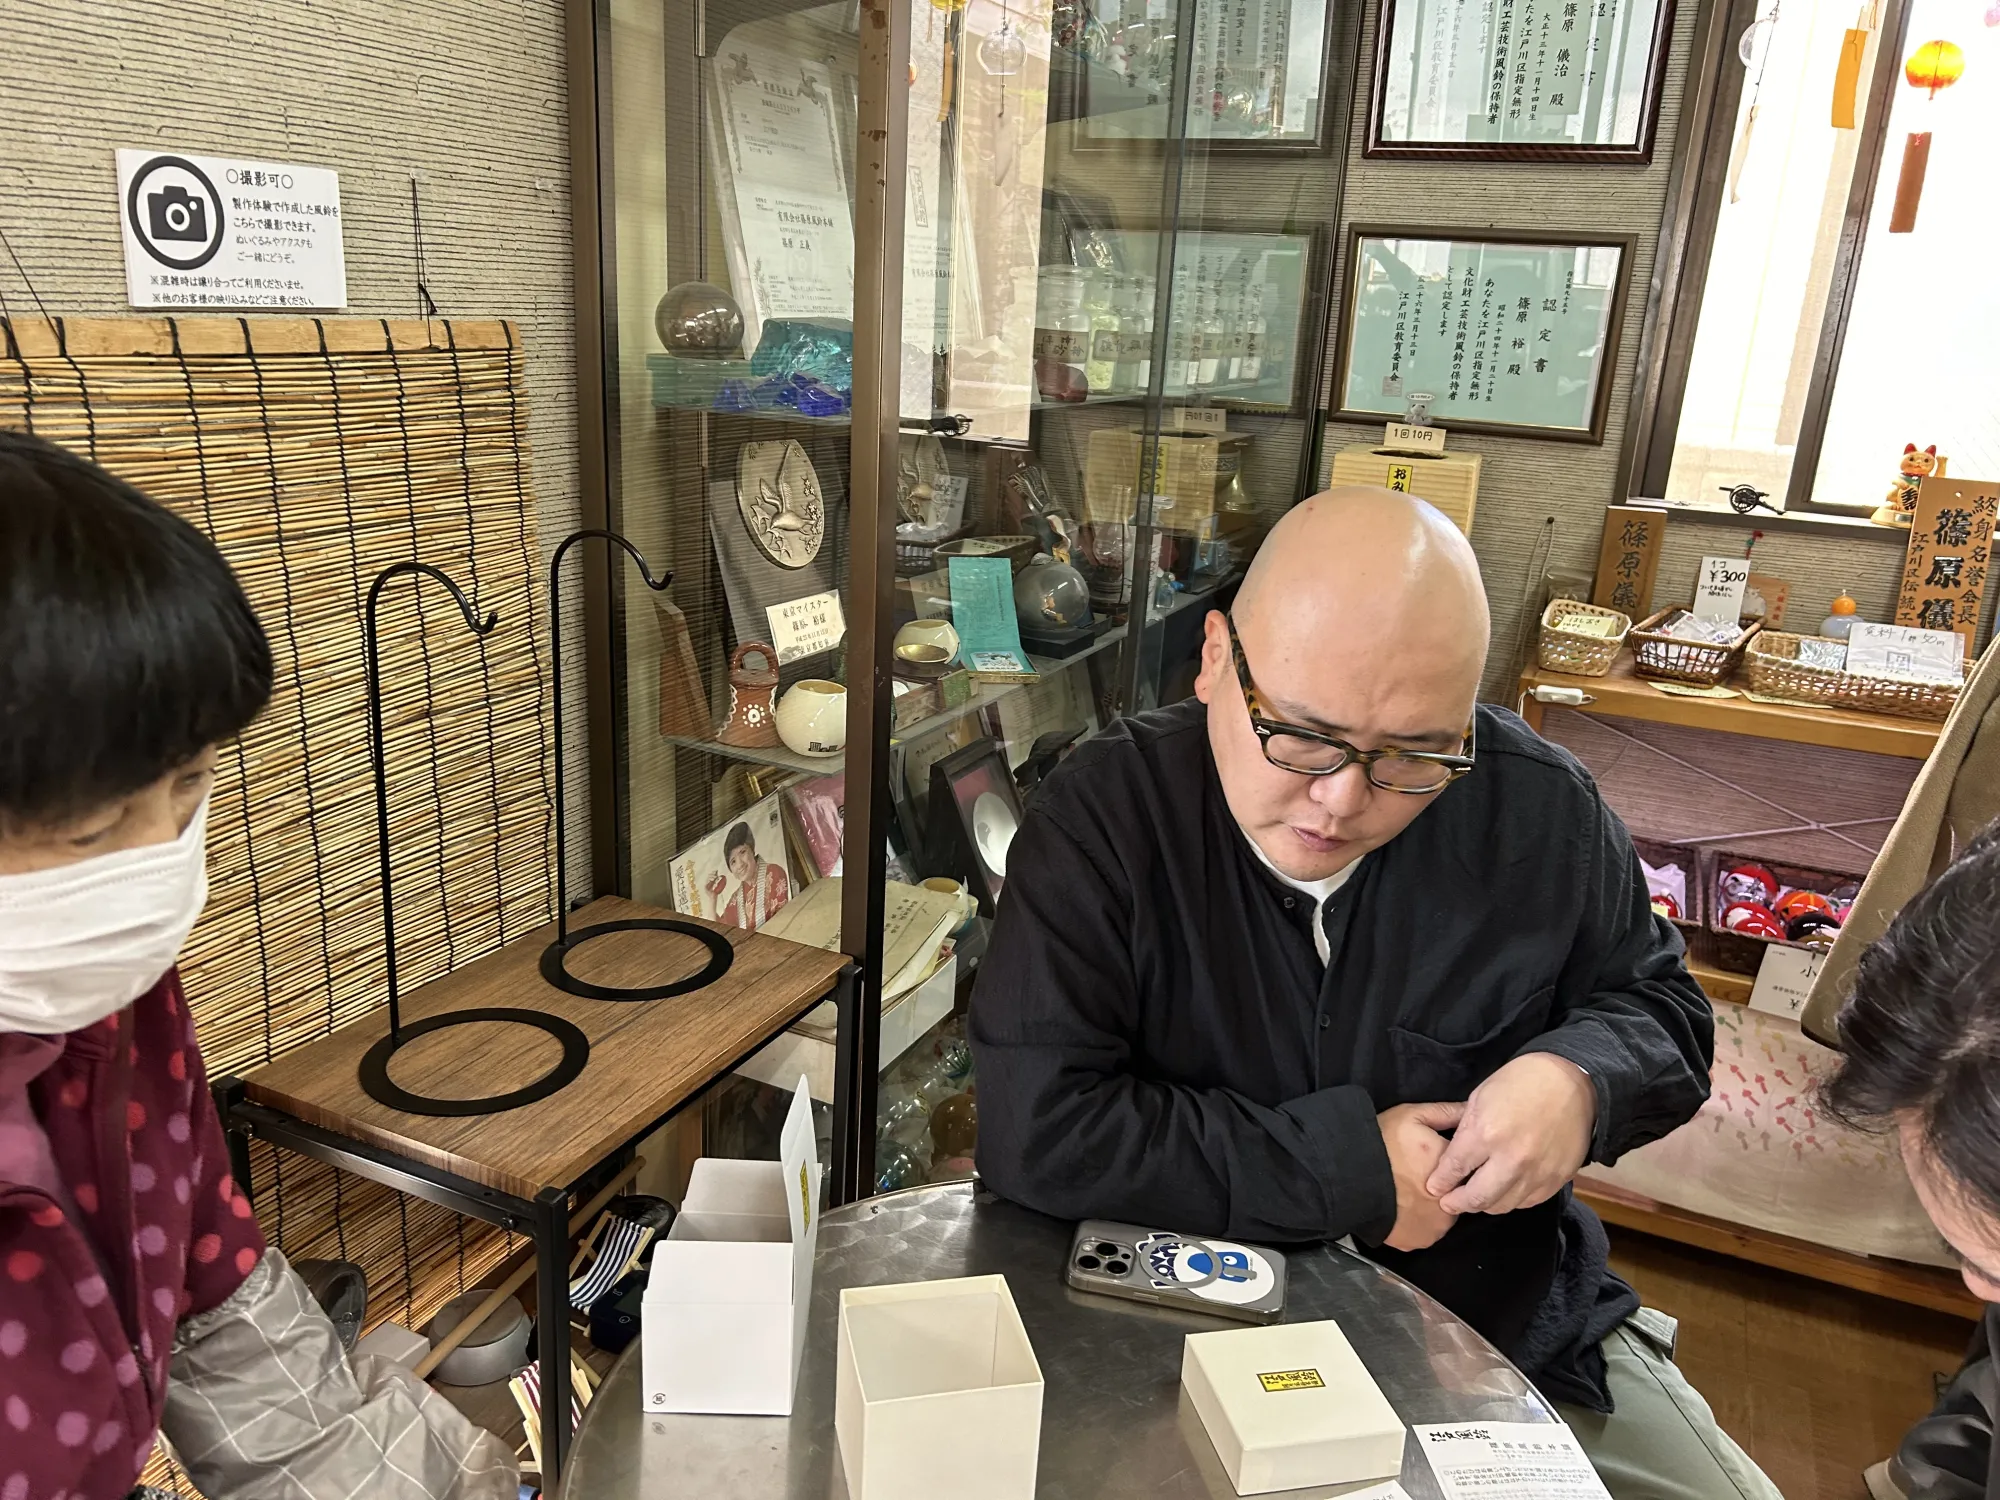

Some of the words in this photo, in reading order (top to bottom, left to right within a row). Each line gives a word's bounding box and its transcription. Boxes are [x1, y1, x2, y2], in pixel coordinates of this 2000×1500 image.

[1561, 2, 1578, 32] 篠原
[1509, 0, 1535, 119] たを江戸川区指定無形
[1528, 12, 1551, 121] 大正十三年十一月十四日生
[1554, 48, 1571, 77] 儀治
[1549, 93, 1565, 106] 殿
[232, 198, 339, 218] 製作体験で作成した風鈴を
[233, 216, 316, 233] こちらで撮影できます。
[236, 235, 313, 249] ぬいぐるみやアクスタも
[237, 252, 295, 264] ご一緒にどうぞ。
[1409, 274, 1426, 357] 成二十六年三月十三日
[1438, 265, 1454, 337] として認定します
[1516, 296, 1531, 324] 篠原
[1389, 291, 1410, 382] 江戸川区教育委員会
[1447, 266, 1475, 401] 文化財工芸技術風鈴の保持者
[1468, 278, 1495, 401] あなたを江戸川区指定無形
[1511, 337, 1525, 350] 裕
[1485, 304, 1506, 402] 昭和二十四年十一月二十日生
[1506, 363, 1521, 376] 殿
[1394, 428, 1433, 441] 1回10円
[1391, 467, 1407, 493] おみ
[1610, 520, 1649, 609] 篠原儀
[1917, 508, 1973, 631] 篠原儀
[1957, 495, 1998, 626] 終身名誉会長
[1709, 569, 1747, 583] ¥300
[1897, 531, 1930, 629] 江戸川区伝統工
[782, 599, 829, 619] 東京マイスター
